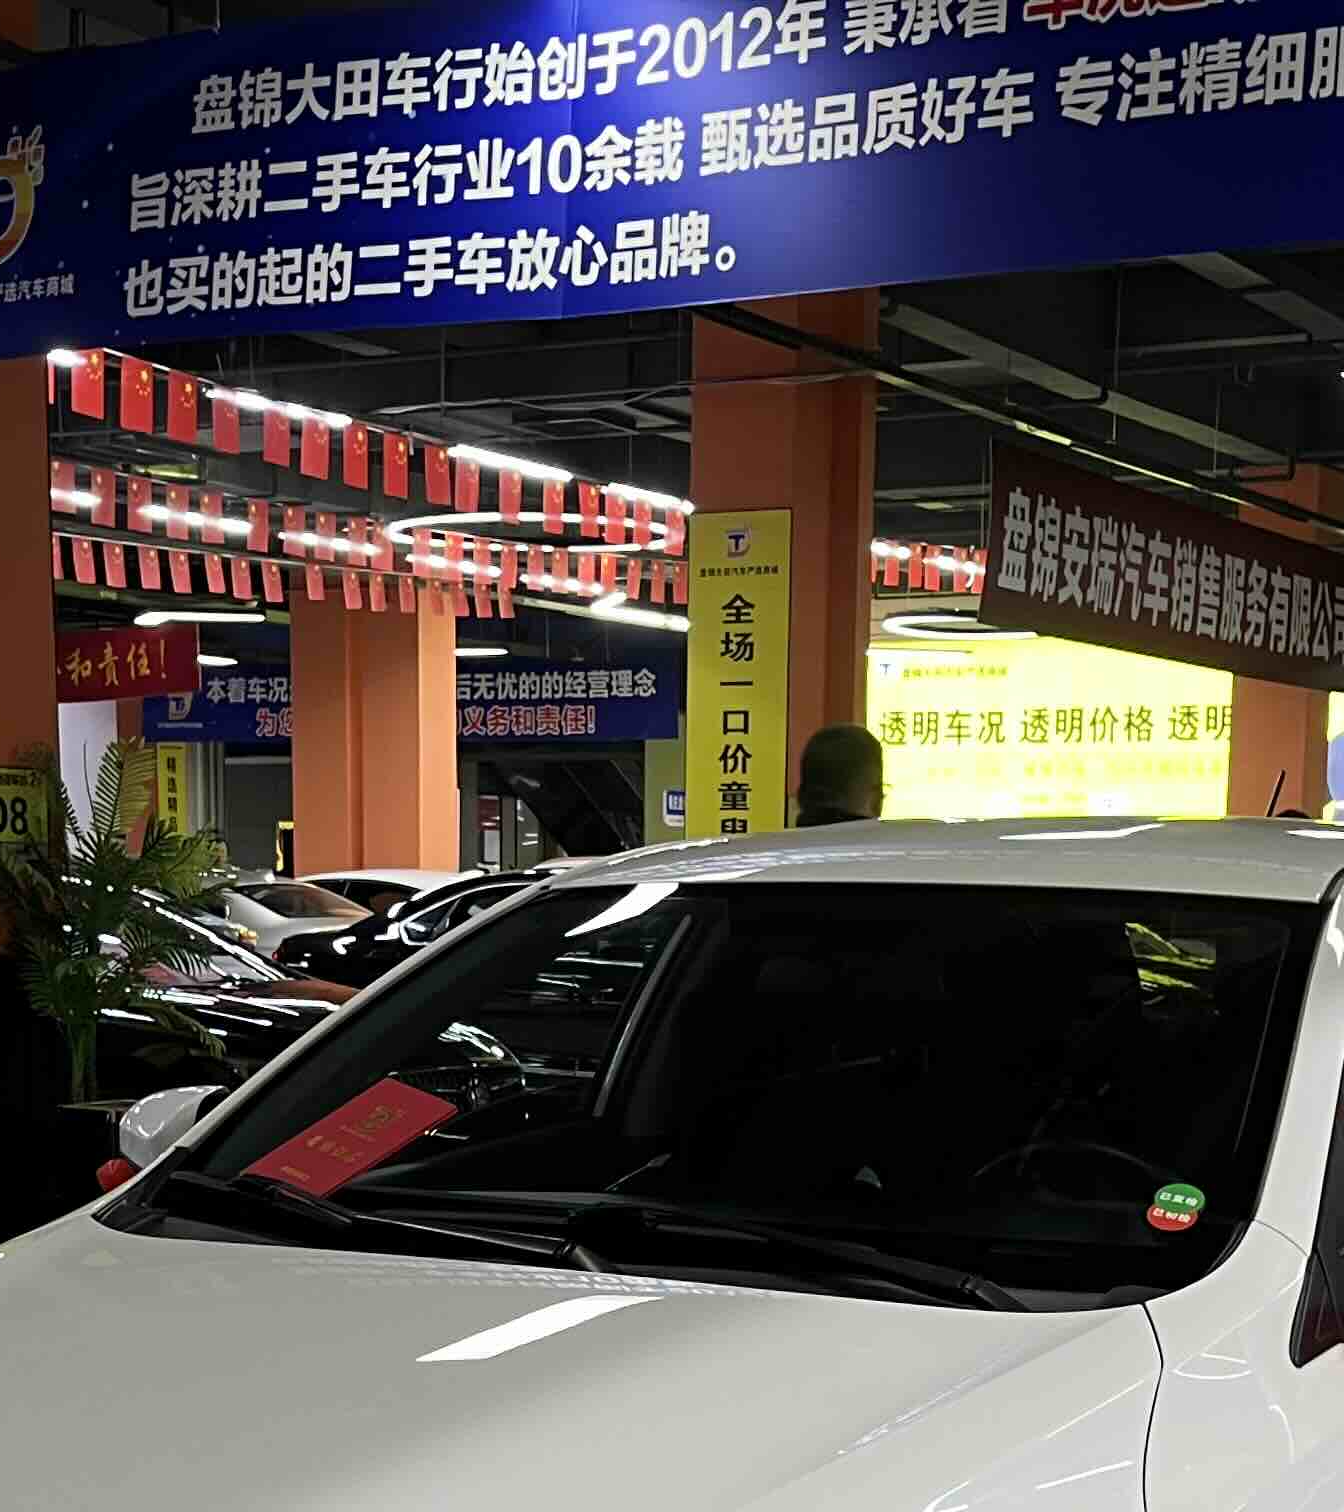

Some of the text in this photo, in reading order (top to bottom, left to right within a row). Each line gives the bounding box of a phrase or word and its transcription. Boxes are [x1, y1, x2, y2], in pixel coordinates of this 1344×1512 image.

[191, 0, 827, 135] 盘锦大田车行始创于2012年
[128, 118, 685, 232] 旨深耕二手车行业10余载
[699, 67, 1035, 178] 甄选品质好车
[122, 209, 737, 319] 也买的起的二手车放心品牌。
[56, 639, 167, 687] 和责任!
[207, 676, 291, 703] 本着车况
[456, 704, 597, 736] 义务和责任!
[879, 703, 1233, 746] 透明车况 透明价格 透明
